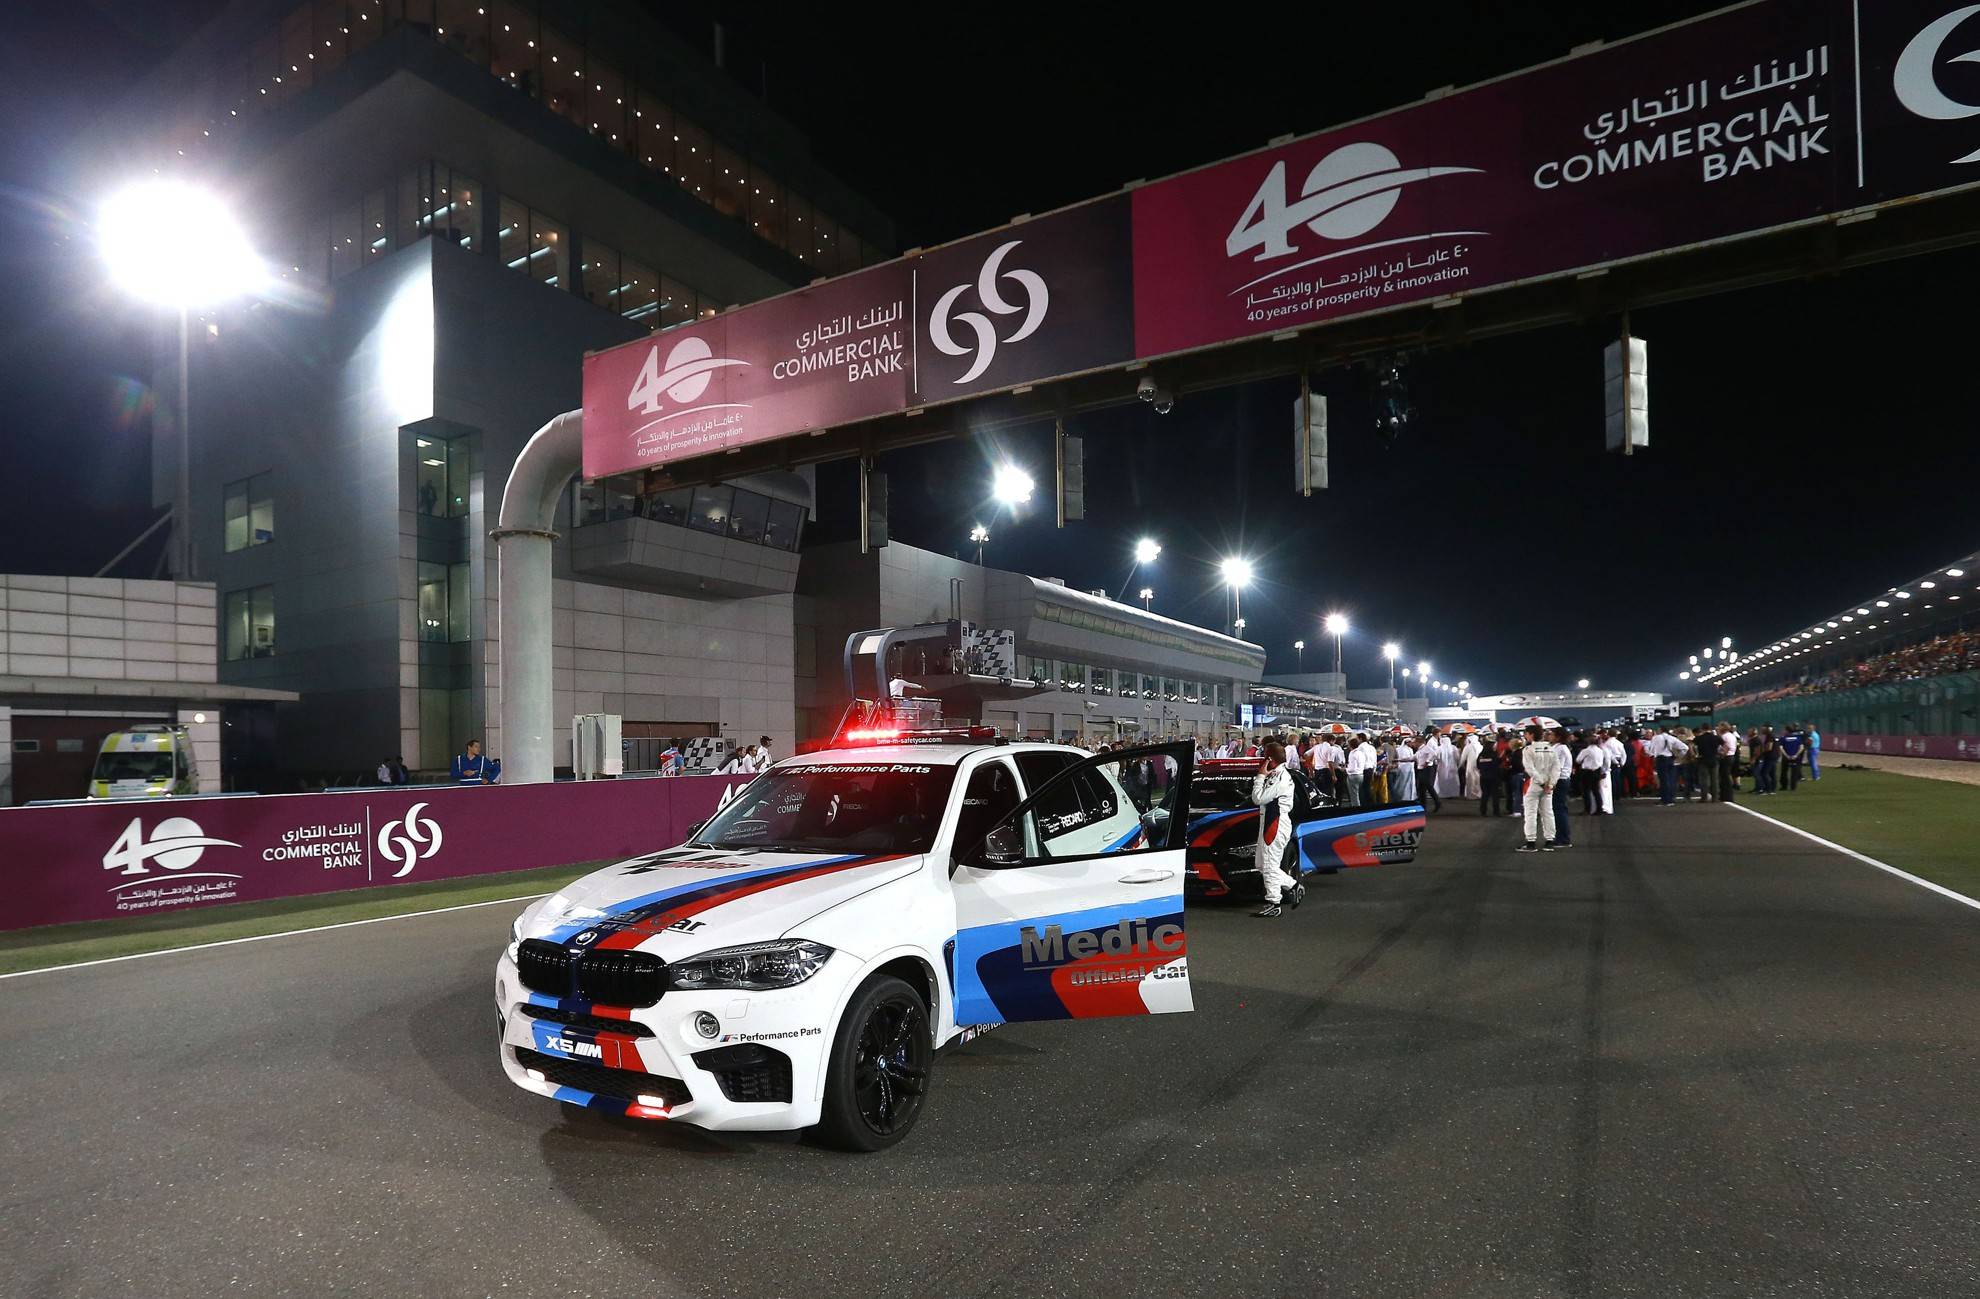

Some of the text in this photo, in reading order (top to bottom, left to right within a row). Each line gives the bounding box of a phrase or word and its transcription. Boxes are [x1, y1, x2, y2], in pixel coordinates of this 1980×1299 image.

[1583, 45, 1828, 146] البنك التجاري
[1534, 95, 1830, 190] COMMERCIAL
[1703, 126, 1830, 182] BANK
[1226, 142, 1402, 262] 40
[1247, 265, 1470, 322] 40 years of prosperity & innovation
[796, 300, 903, 353] البنك التجاري
[773, 331, 903, 380] COMMERCIAL
[848, 352, 903, 382] BANK
[628, 337, 713, 415] 40
[637, 447, 647, 457] 40
[646, 444, 663, 457] years
[664, 441, 670, 453] of
[671, 436, 702, 452] prosperity
[709, 427, 743, 441] innovation
[802, 764, 888, 774] Performance
[889, 764, 931, 774] Parts
[102, 817, 205, 875] 40
[262, 841, 362, 861] COMMERCIAL
[282, 822, 361, 845] البنك التجاري
[1355, 829, 1423, 848] Safety
[324, 853, 363, 869] BANK
[116, 903, 128, 911] 40
[129, 901, 149, 911] years
[150, 899, 158, 908] of
[201, 890, 237, 902] innovation
[1019, 917, 1185, 964] Medic
[1071, 963, 1188, 986] Official Car
[740, 1026, 822, 1042] Performance Parts
